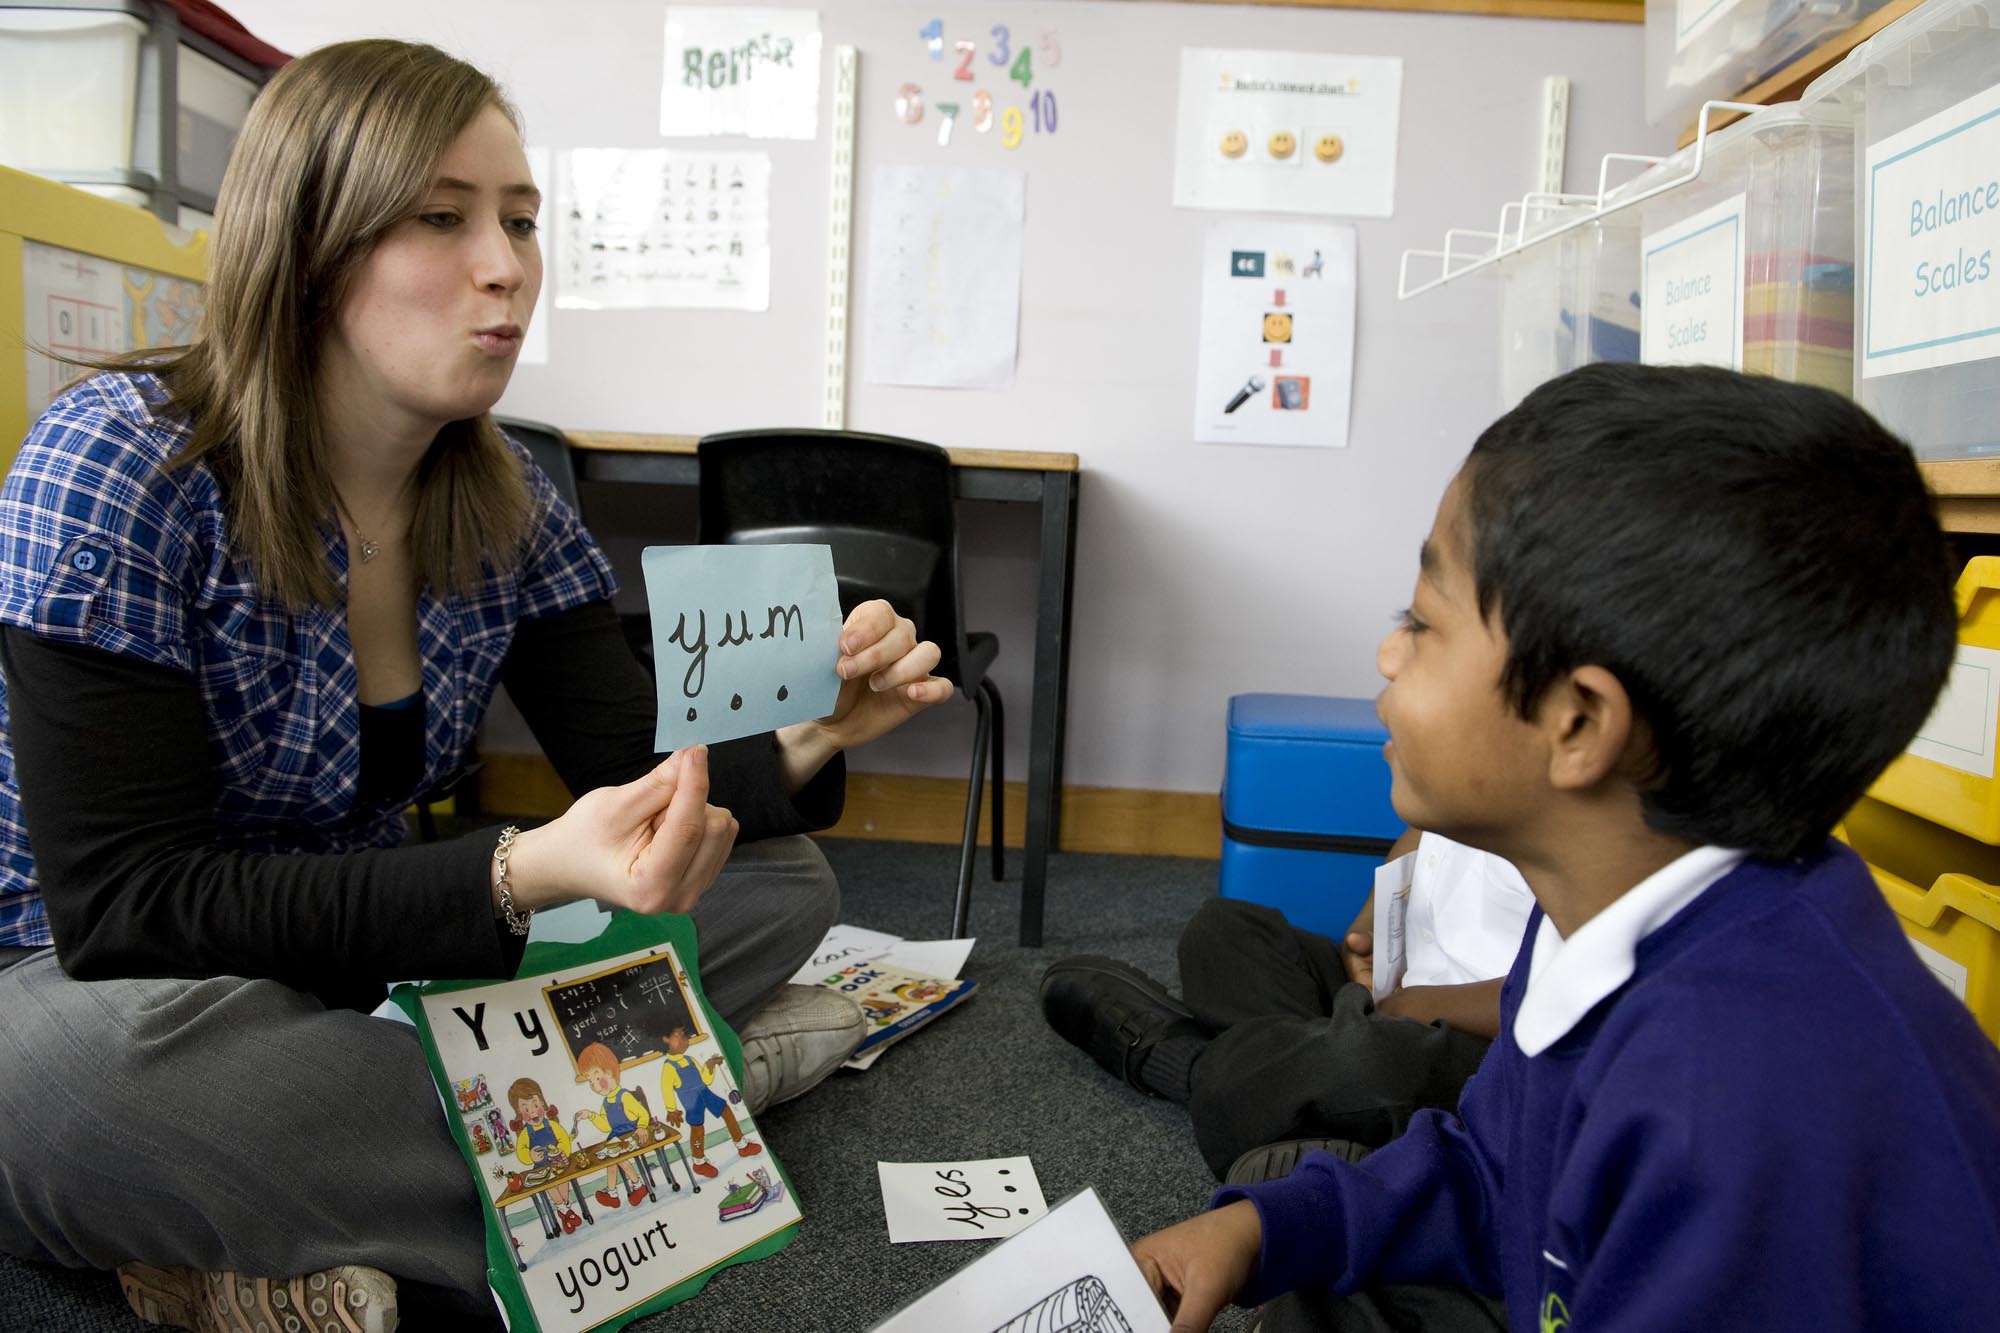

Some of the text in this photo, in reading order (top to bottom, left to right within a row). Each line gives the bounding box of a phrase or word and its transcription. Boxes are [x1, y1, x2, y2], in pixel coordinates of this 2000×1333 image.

[919, 18, 943, 60] 1
[954, 41, 975, 81] 2
[988, 24, 1010, 66] 3
[1010, 46, 1033, 88] 4
[896, 83, 1057, 148] 6 7 8 9 10
[1910, 181, 2000, 237] Balance
[1665, 273, 1712, 306] Balance
[1914, 247, 1992, 297] Scales
[1668, 318, 1707, 349] Scales
[668, 604, 804, 698] yum
[452, 1002, 550, 1056] Y y
[572, 1012, 597, 1038] yard
[597, 1024, 619, 1040] year
[935, 1169, 1011, 1230] yes
[555, 1219, 677, 1313] yogurt
